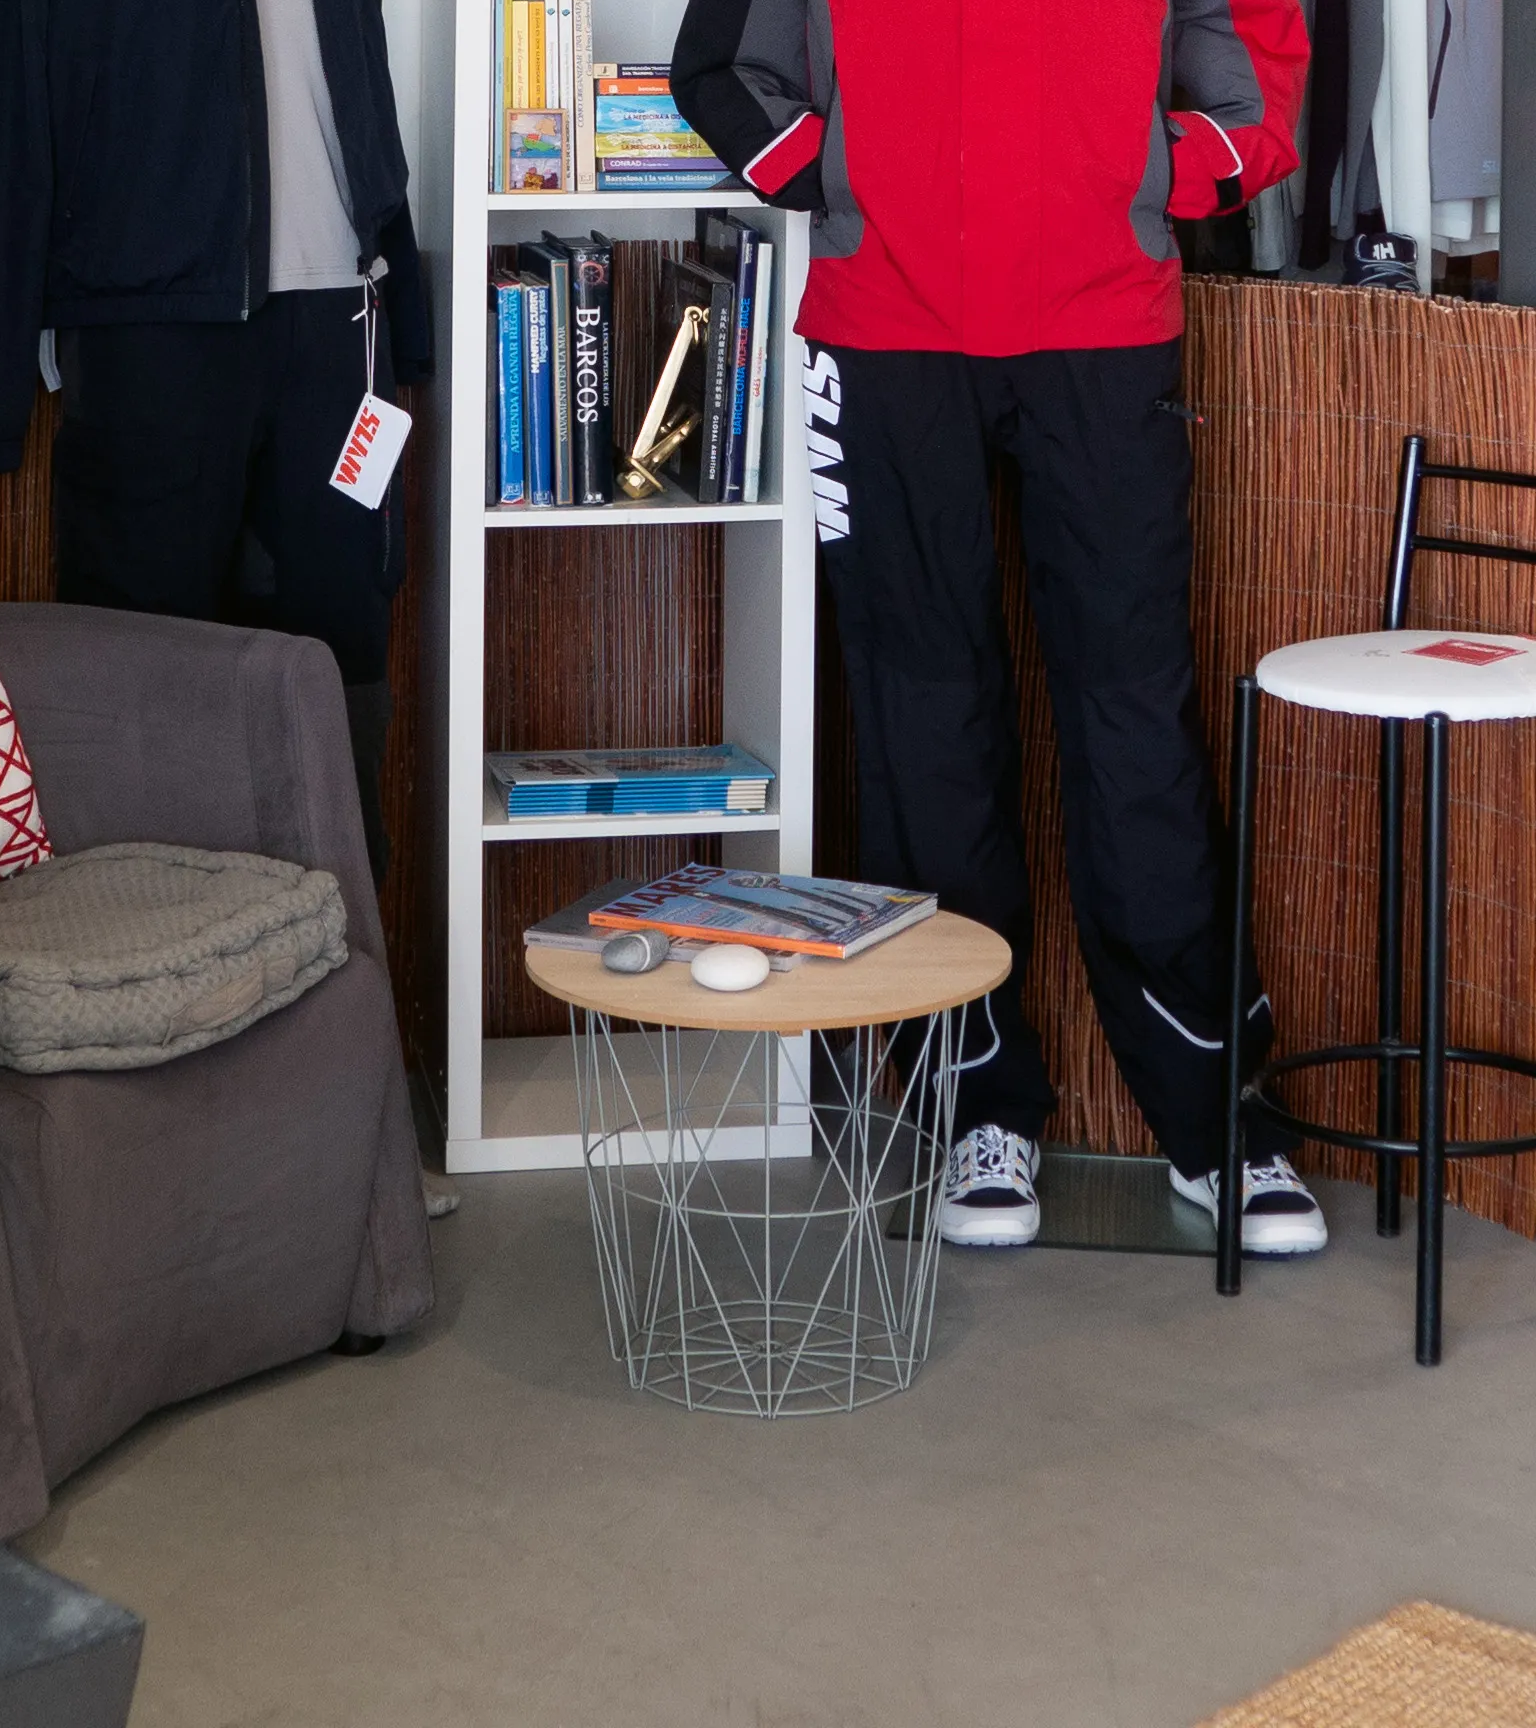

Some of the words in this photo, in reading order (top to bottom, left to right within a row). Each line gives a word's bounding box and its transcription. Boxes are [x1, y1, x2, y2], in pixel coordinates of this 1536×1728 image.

[675, 174, 715, 182] tradicional
[509, 288, 519, 338] REGATAS
[530, 290, 539, 323] CURRY
[538, 289, 548, 314] yates
[539, 314, 547, 326] de
[530, 324, 540, 373] MANFRED
[539, 327, 549, 363] Regatas
[557, 326, 566, 349] MAR
[558, 350, 567, 363] LA
[509, 342, 519, 384] GANAR
[558, 365, 567, 379] EN
[575, 306, 601, 423] BARCOS
[510, 393, 520, 453] APRENDA
[559, 379, 568, 442] SALVAMENTO
[711, 414, 720, 442] GLOBAL
[335, 405, 382, 486] SLAM
[803, 336, 851, 543] SLAM
[601, 866, 727, 919] MARES
